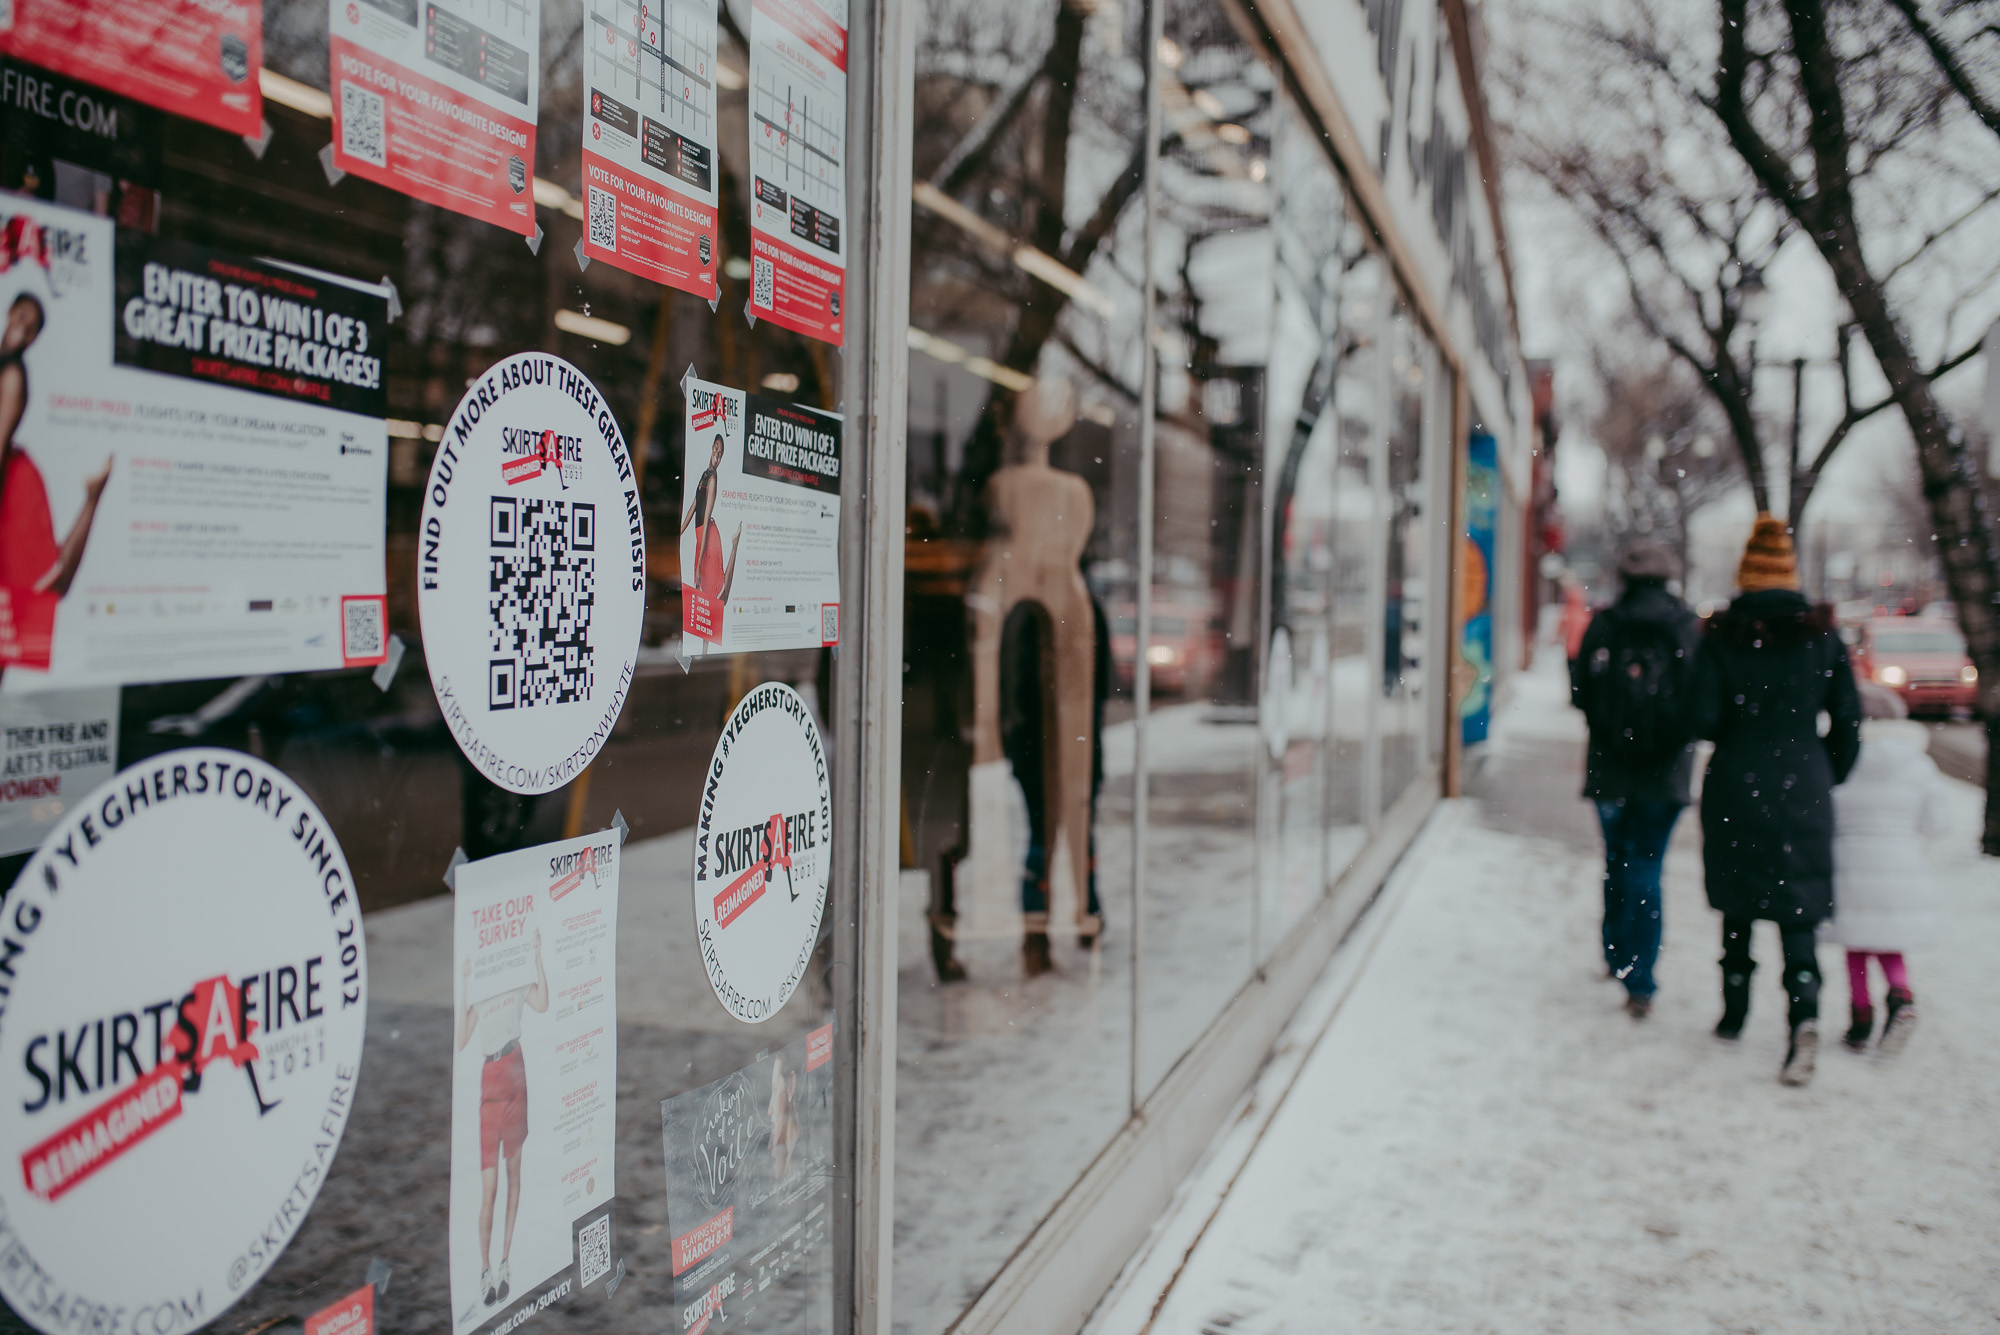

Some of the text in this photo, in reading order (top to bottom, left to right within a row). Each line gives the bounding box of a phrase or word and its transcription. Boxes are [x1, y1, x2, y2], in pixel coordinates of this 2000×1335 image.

[0, 69, 118, 140] FIRE.COM
[340, 53, 371, 83] VOTE
[374, 68, 397, 94] FOR
[398, 78, 430, 106] YOUR
[432, 95, 488, 133] FAVOURITE
[488, 120, 528, 149] DESIGN!
[588, 164, 609, 184] VOTE
[610, 175, 624, 192] FOR
[625, 181, 646, 201] YOUR
[646, 191, 683, 217] FAVOURITE
[684, 207, 712, 229] DESIGN!
[753, 238, 768, 255] VOTE
[768, 244, 780, 259] FOR
[780, 250, 793, 266] YOUR
[143, 261, 369, 353] ENTER TO WIN 1 OF 3
[122, 295, 382, 390] GREAT PRIZE PACKAGES!
[502, 359, 554, 395] ABOUT
[558, 365, 600, 420] THESE
[692, 388, 739, 418] SKIRTSAFIRE
[454, 376, 500, 447] MORE
[755, 413, 836, 456] ENTER TO WIN 1 OF 3
[502, 426, 583, 463] SKIRTSAFIRE
[502, 459, 542, 482] REIMAGINED
[598, 410, 632, 483] GREAT
[747, 433, 840, 478] GREAT PRIZE PACKAGES!
[432, 442, 459, 508] OUT
[564, 470, 583, 481] 2021
[721, 489, 737, 499] GRAND
[737, 491, 748, 500] PRIZE
[423, 516, 442, 591] FIND
[624, 489, 644, 593] ARTISTS
[80, 718, 109, 741] AND
[434, 660, 635, 790] SKIRTSAFIRE.COM/SKIRTSONWHYTE
[3, 751, 44, 776] ARTS
[696, 687, 829, 881] MAKING #YEGHERSTORY SINCE 2012
[550, 843, 613, 879] SKIRTSAFIRE
[714, 810, 816, 879] SKIRTSAFIRE
[793, 862, 816, 882] 2021
[292, 811, 349, 917] SINCE
[336, 918, 361, 1010] 2012
[472, 894, 535, 929] TAKE OUR
[716, 867, 765, 924] REIMAGINED
[478, 916, 527, 950] SURVEY
[778, 880, 827, 1004] @SKIRTSAFIRE
[699, 918, 772, 1019] SKIRTSAFIRE.COM
[23, 956, 324, 1115] SKIRTSAFIRE
[267, 1042, 326, 1082] 2021
[28, 1074, 181, 1198] REIMAGINED
[705, 1082, 745, 1144] makings
[717, 1114, 736, 1145] of a
[227, 1063, 354, 1292] @SKIRTSAFIRE
[700, 1115, 754, 1195] Voice
[681, 1210, 732, 1251] PLAYING ONLINE
[682, 1223, 732, 1267] MARCH 8-14
[683, 1270, 736, 1330] SKIRTSAFIRE
